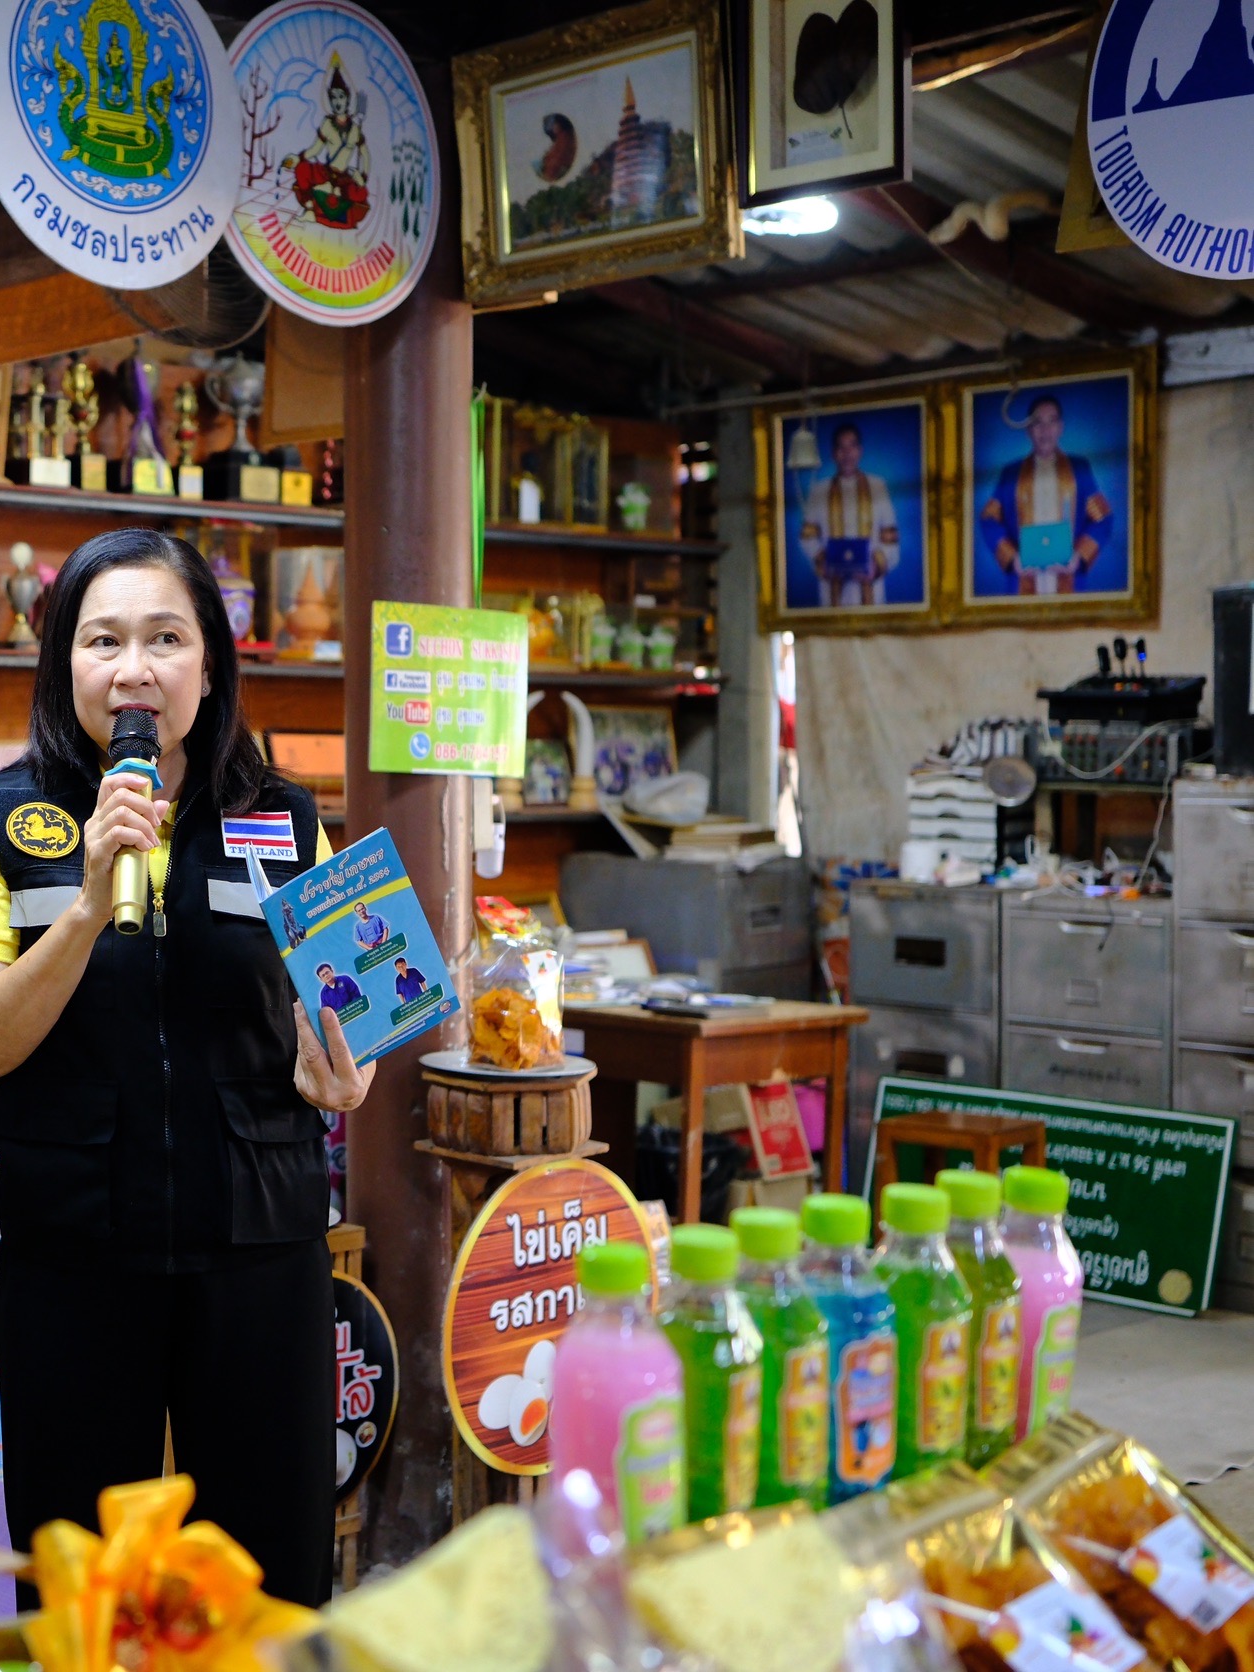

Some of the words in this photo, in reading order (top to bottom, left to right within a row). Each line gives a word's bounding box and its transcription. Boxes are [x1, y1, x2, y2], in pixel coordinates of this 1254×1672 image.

[12, 172, 215, 264] กรมชลประทาน
[1094, 125, 1167, 242] TOURISM
[1156, 213, 1254, 273] AUTHO
[229, 846, 293, 857] THILAND
[1070, 1177, 1107, 1202] นาย
[506, 1198, 608, 1268] ไข่เค็ม
[1078, 1249, 1150, 1291] ศูนย์เรีย
